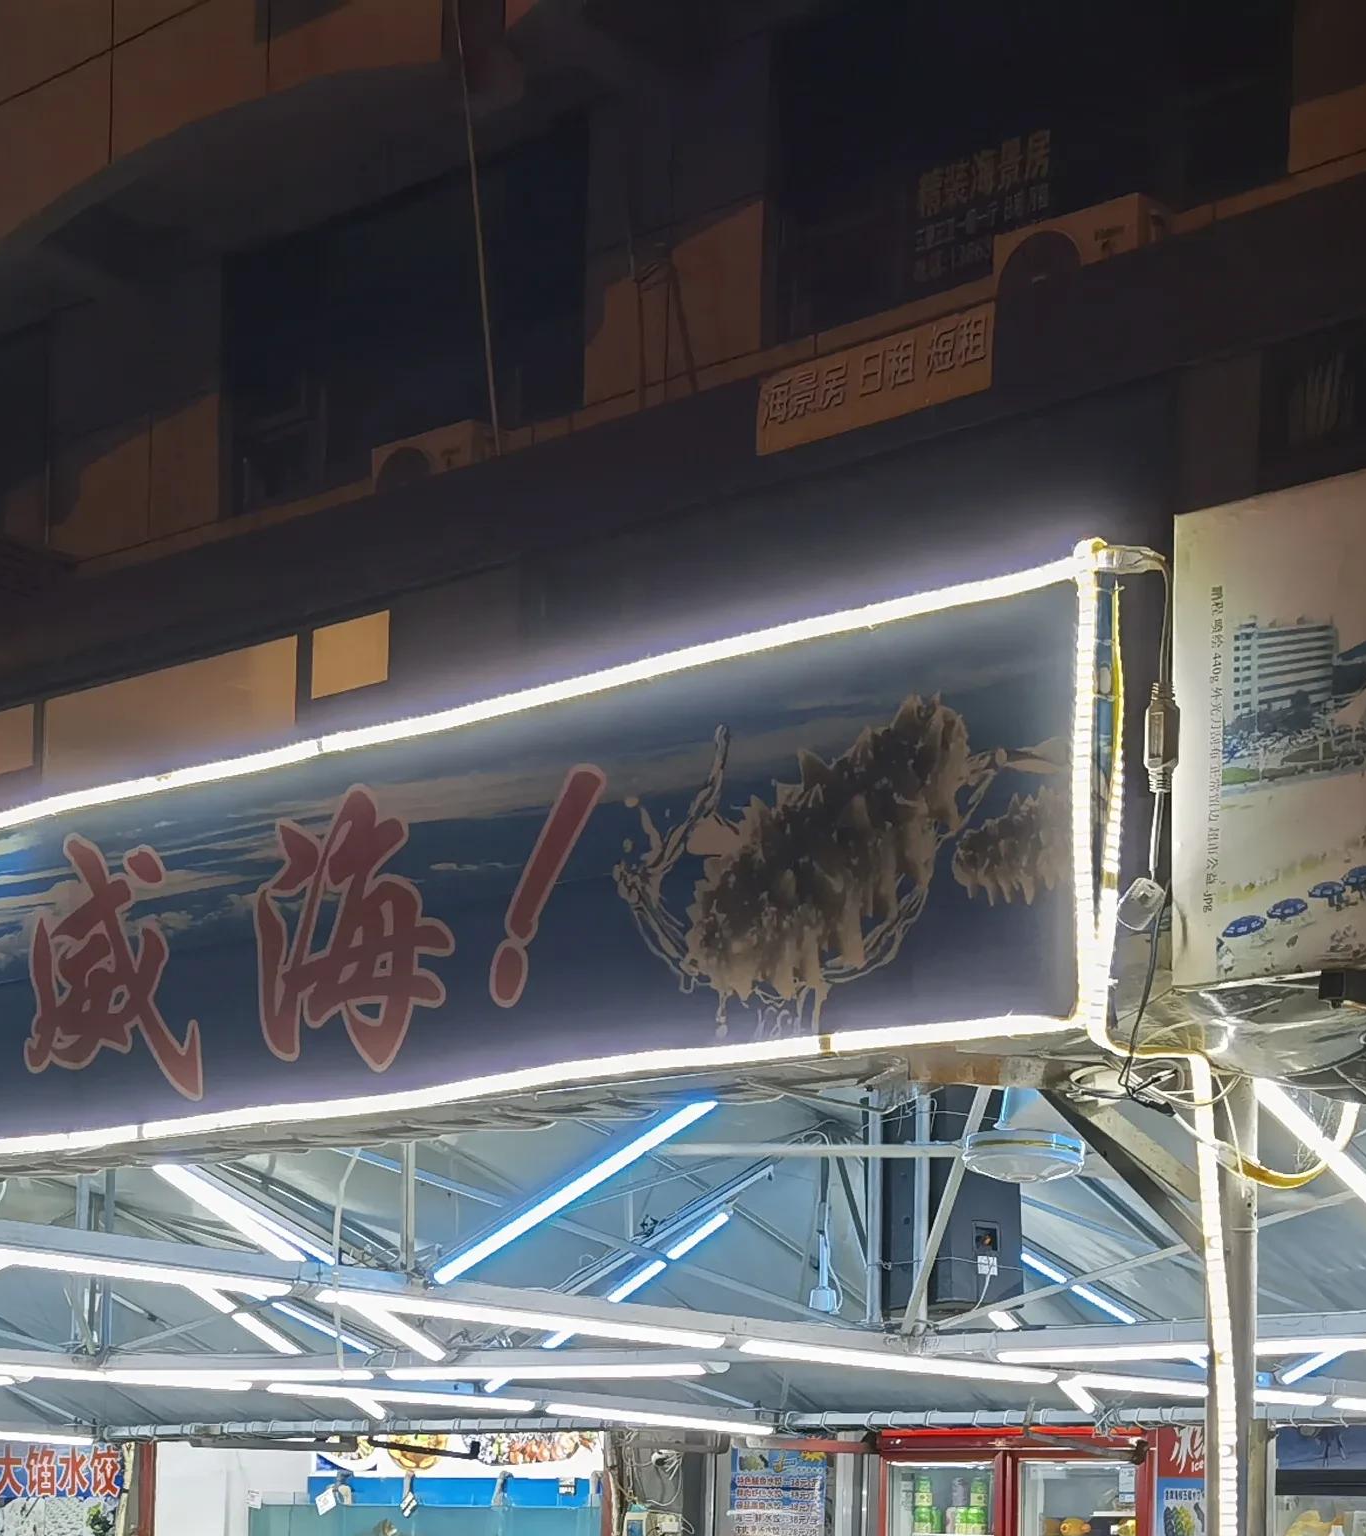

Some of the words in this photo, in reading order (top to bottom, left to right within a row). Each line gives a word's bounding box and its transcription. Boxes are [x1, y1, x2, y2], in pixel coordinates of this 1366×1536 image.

[762, 361, 848, 429] 海景房
[859, 341, 916, 398] 日租
[1209, 652, 1223, 684] 440g
